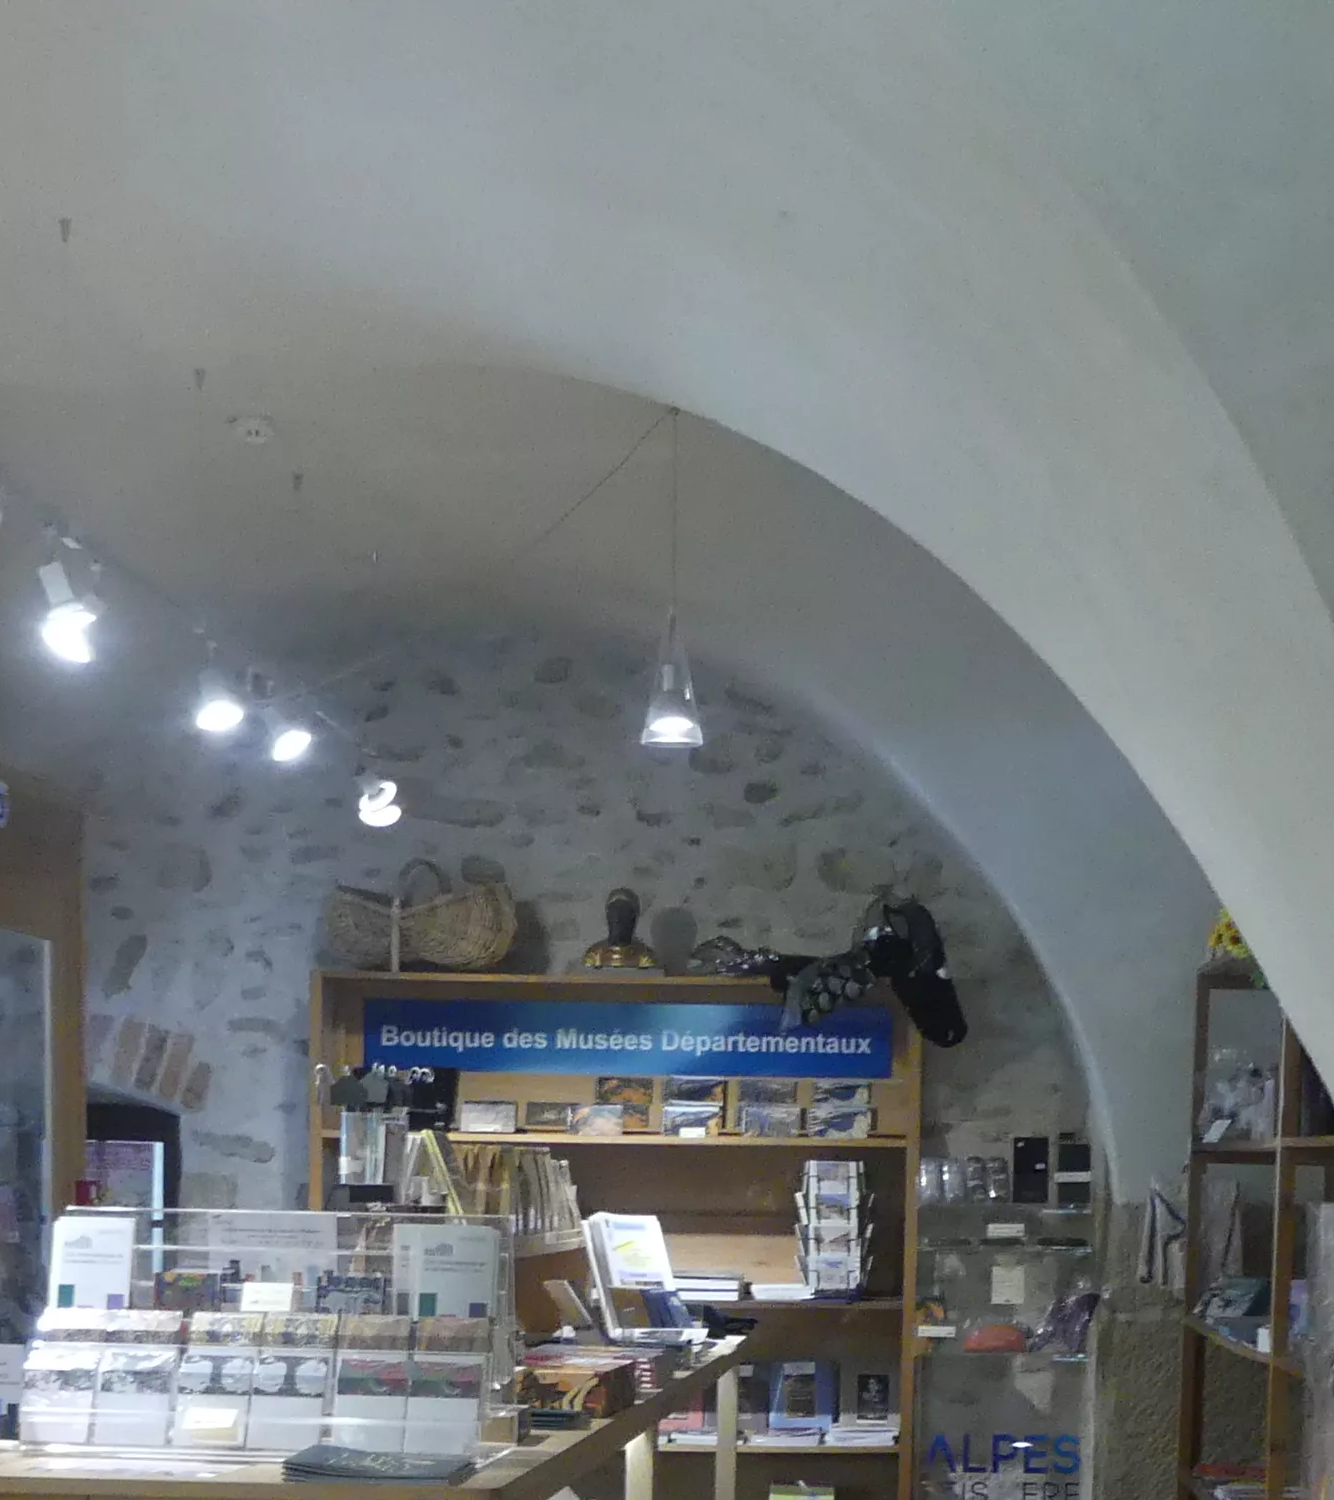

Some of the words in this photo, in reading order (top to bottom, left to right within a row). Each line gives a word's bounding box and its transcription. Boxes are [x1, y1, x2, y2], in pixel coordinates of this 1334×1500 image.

[380, 1024, 495, 1054] Boutique
[502, 1028, 548, 1050] des
[555, 1027, 653, 1051] Musées
[660, 1029, 872, 1058] Départementaux
[926, 1431, 1081, 1475] ALPES
